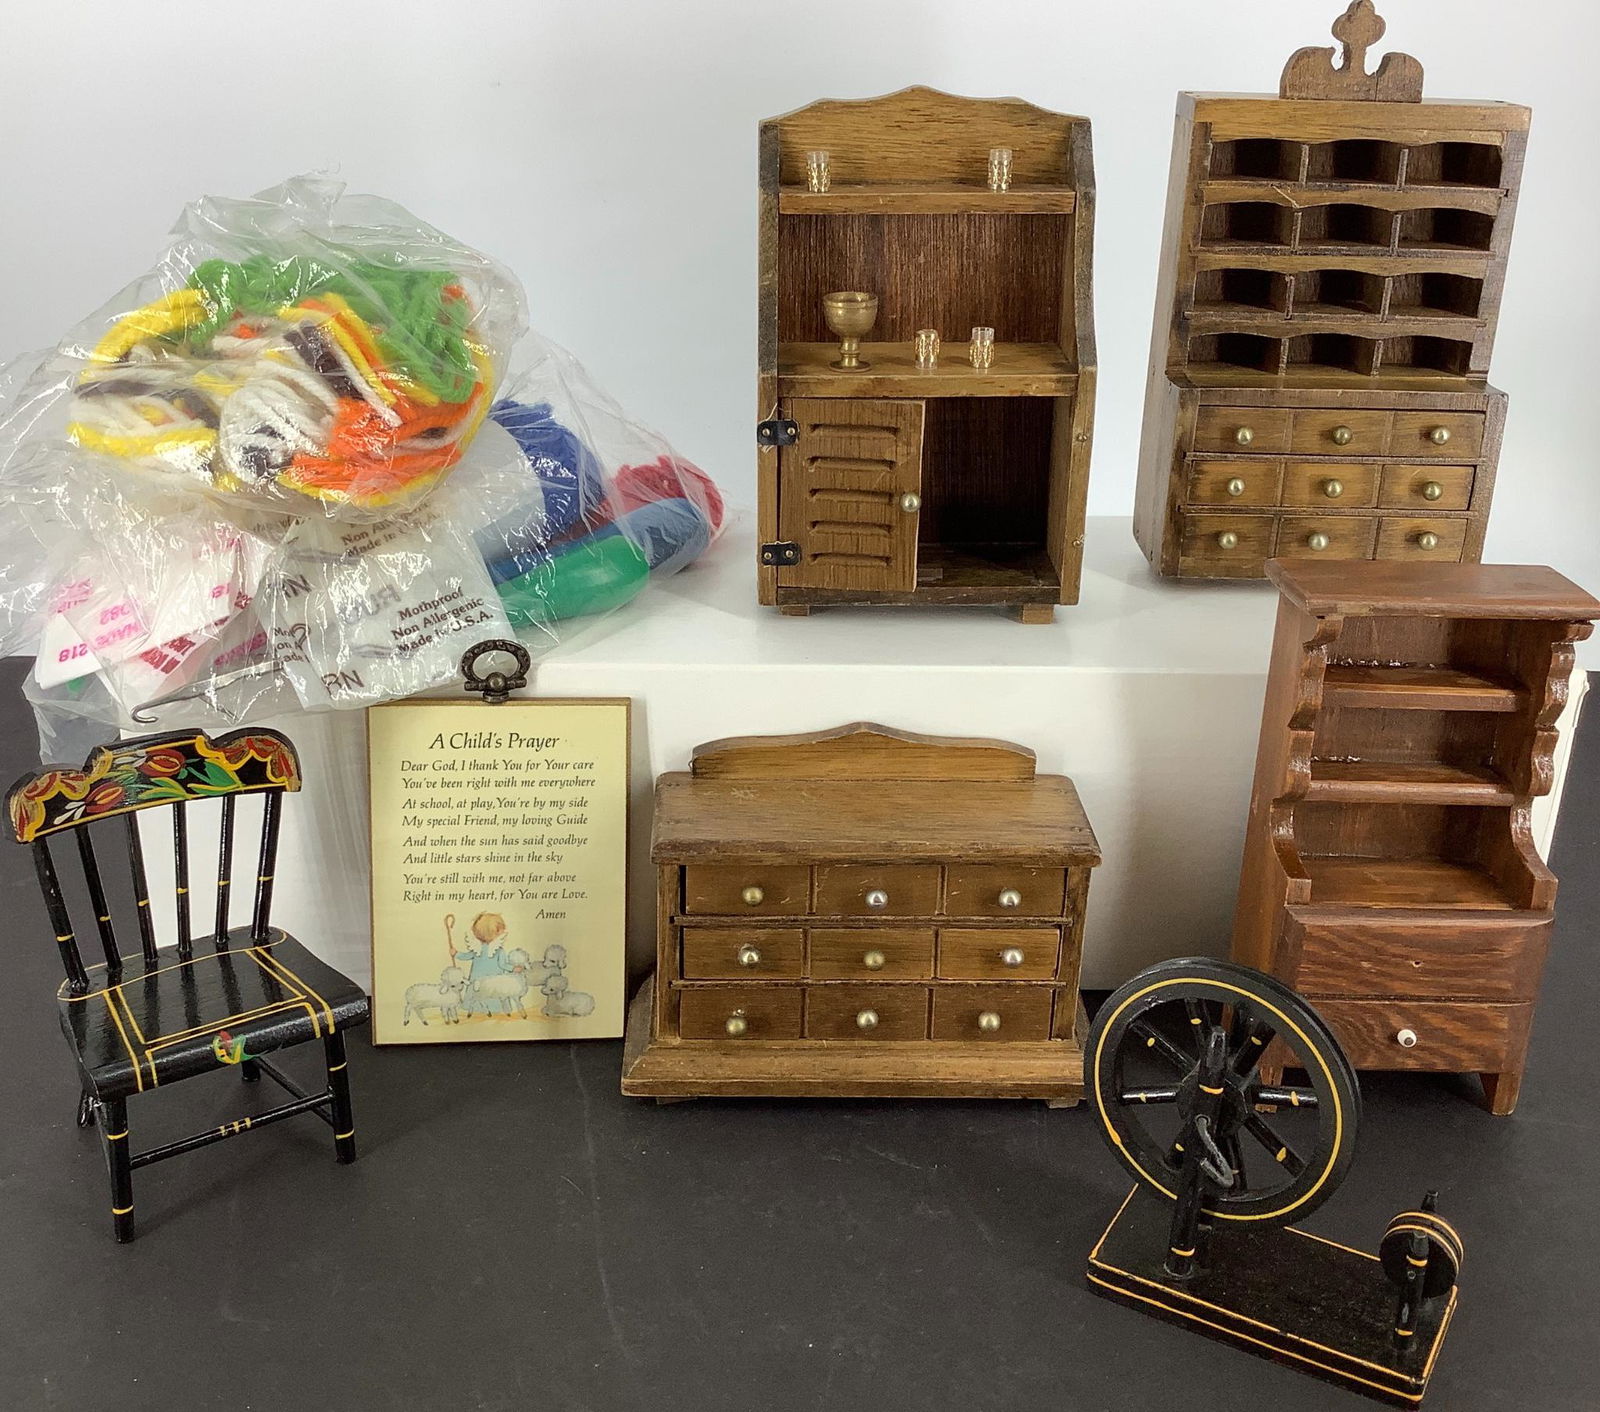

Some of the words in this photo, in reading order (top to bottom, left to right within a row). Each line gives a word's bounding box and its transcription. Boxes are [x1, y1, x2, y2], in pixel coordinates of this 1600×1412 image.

[341, 531, 370, 547] Non
[398, 586, 465, 621] Mothproof
[391, 623, 421, 642] Non
[422, 596, 486, 630] Allergenic
[58, 642, 88, 663] 218
[429, 732, 446, 750] A
[449, 731, 503, 750] Child's
[507, 732, 561, 753] Prayer
[400, 760, 429, 772] Dear
[431, 759, 459, 773] God,
[460, 759, 466, 772] I
[468, 758, 500, 771] thank
[501, 758, 523, 771] You
[524, 759, 542, 773] for
[543, 758, 571, 771] Your
[572, 761, 595, 770] care
[401, 777, 438, 790] You've
[440, 776, 463, 789] been
[466, 776, 491, 791] right
[494, 775, 518, 788] with
[520, 779, 536, 788] me
[538, 775, 596, 790] everywhere
[401, 797, 417, 810] At
[419, 796, 454, 810] school,
[456, 798, 468, 809] at
[532, 796, 547, 811] by
[549, 800, 566, 811] my
[568, 795, 589, 808] side
[401, 815, 424, 829] My
[426, 813, 461, 829] special
[463, 813, 500, 827] Friend,
[502, 817, 519, 828] my
[521, 813, 553, 828] loving
[556, 812, 589, 825] Guide
[402, 835, 428, 847] And
[429, 834, 458, 847] when
[460, 834, 477, 847] the
[479, 838, 498, 847] sun
[501, 834, 520, 846] has
[522, 833, 545, 846] said
[546, 833, 589, 848] goodbye
[402, 851, 428, 865] And
[430, 851, 453, 864] little
[455, 853, 482, 864] stars
[483, 851, 511, 863] shine
[513, 852, 524, 863] in
[527, 850, 543, 863] the
[545, 850, 564, 865] sky
[402, 873, 438, 885] You're
[439, 871, 460, 884] still
[462, 871, 486, 884] with
[488, 875, 506, 884] me,
[508, 872, 525, 883] not
[527, 871, 545, 886] far
[546, 871, 577, 883] above
[403, 889, 432, 904] Right
[434, 890, 445, 901] in
[448, 892, 465, 903] my
[468, 888, 498, 901] heart,
[499, 889, 516, 902] for
[517, 888, 538, 900] You
[541, 891, 559, 900] are
[561, 887, 588, 899] Love.
[535, 908, 567, 920] Amen
